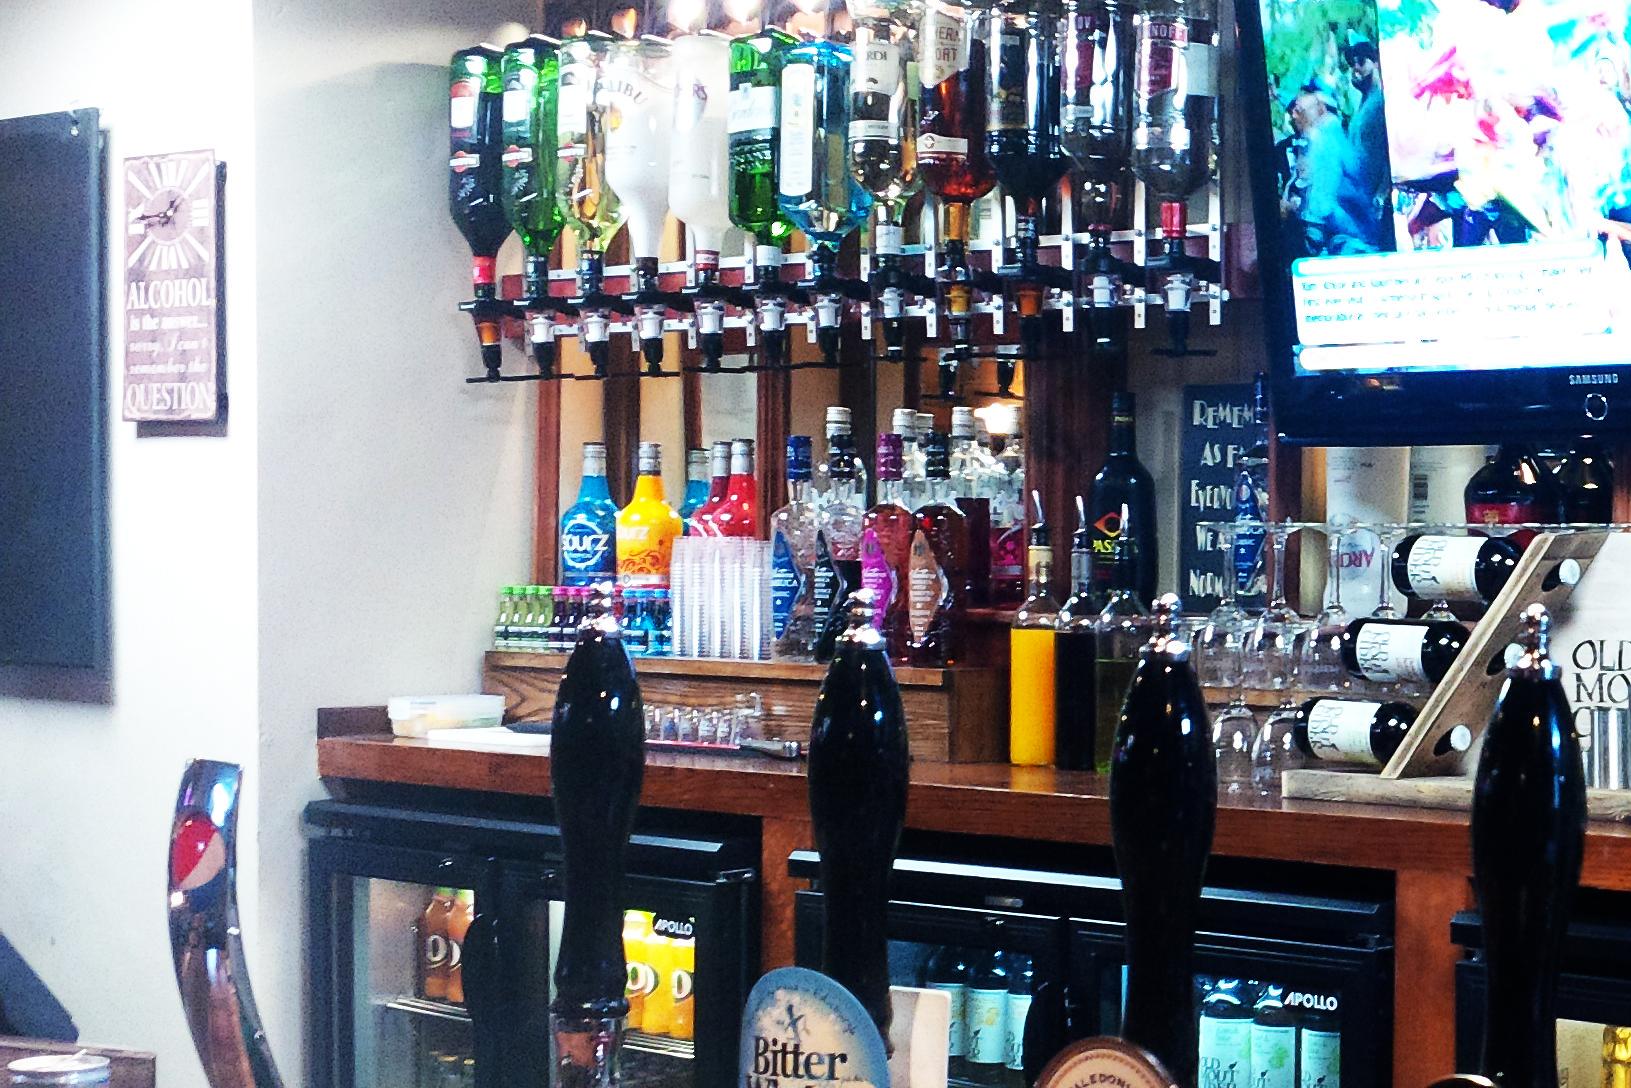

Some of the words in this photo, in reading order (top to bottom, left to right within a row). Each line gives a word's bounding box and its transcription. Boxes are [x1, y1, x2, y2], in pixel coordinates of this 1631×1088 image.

[127, 278, 216, 309] ALCOHOL
[1568, 373, 1619, 385] SAMSUNG
[127, 382, 213, 414] QUESTION
[1193, 400, 1255, 428] REMEM
[1201, 441, 1222, 466] AS
[653, 917, 693, 935] APOLLO
[1284, 991, 1338, 1011] APOLLO
[753, 1036, 849, 1080] Bitter
